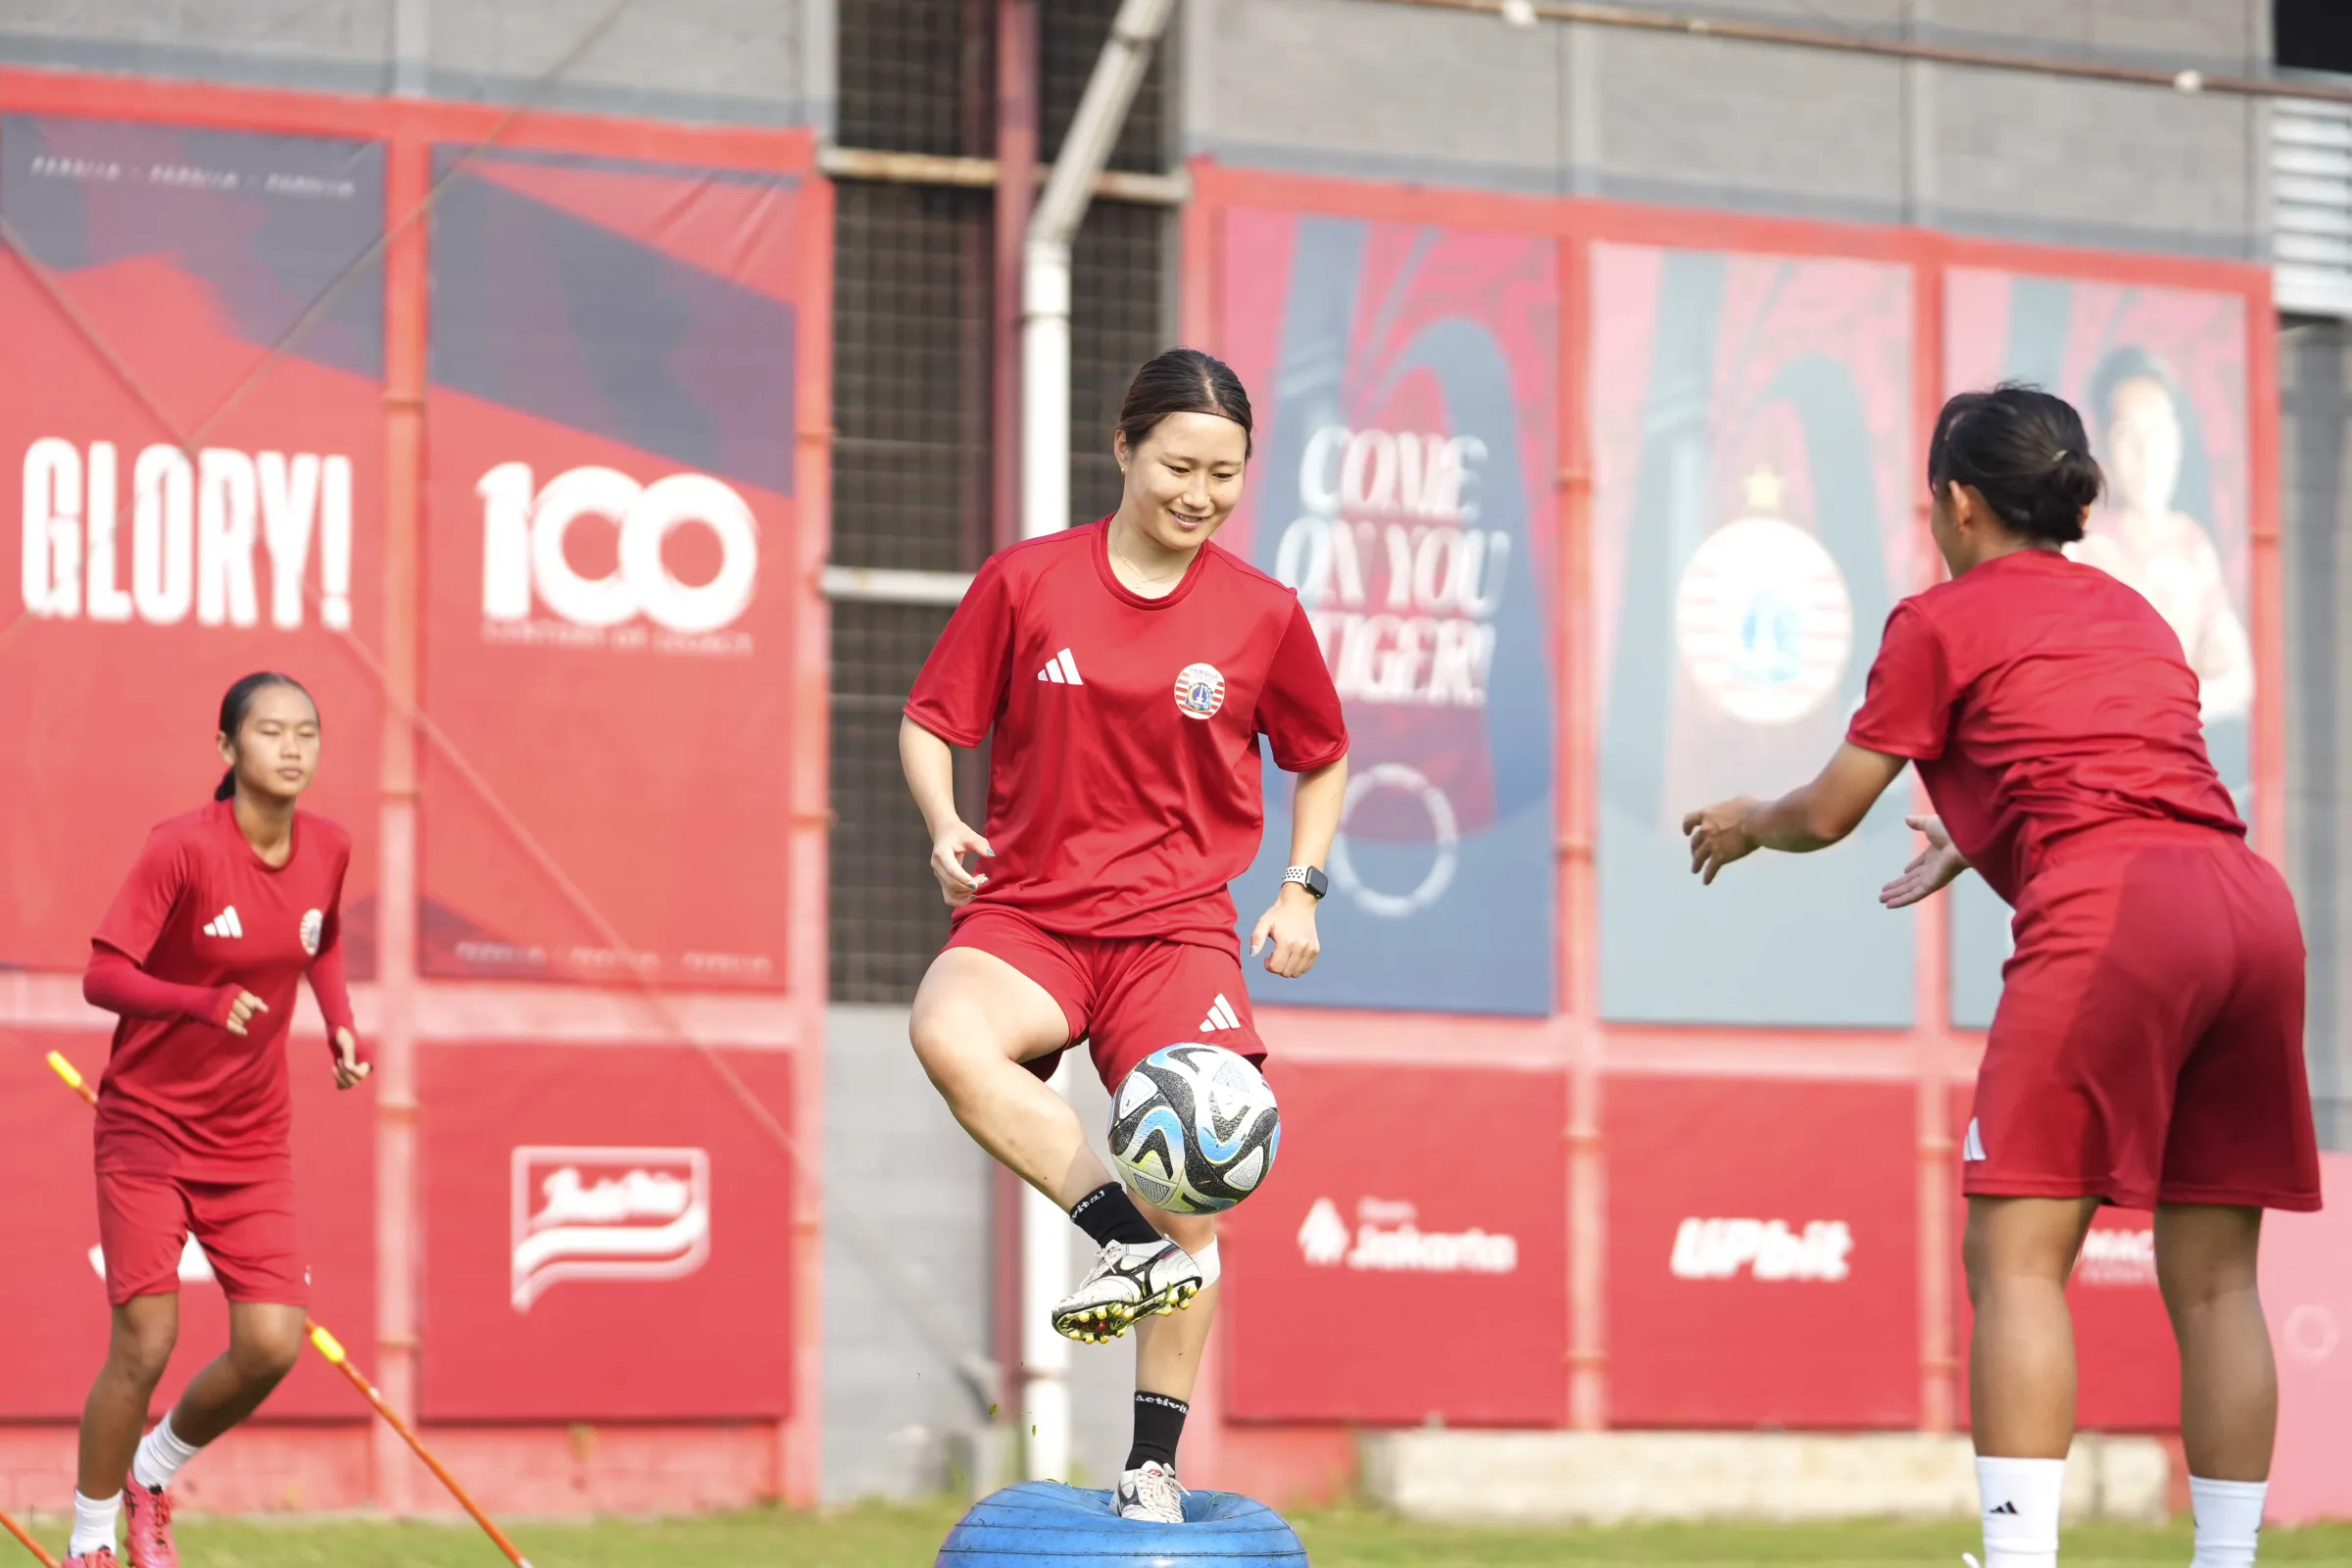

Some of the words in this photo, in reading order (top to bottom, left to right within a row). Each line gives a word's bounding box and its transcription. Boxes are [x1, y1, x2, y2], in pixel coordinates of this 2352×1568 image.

[23, 436, 351, 630] GLORY!
[474, 460, 760, 634] 100
[1276, 516, 1378, 610] ON
[1383, 523, 1509, 617] YOU
[1189, 666, 1218, 679] PERSIJA
[1347, 1225, 1518, 1275] Jakarta
